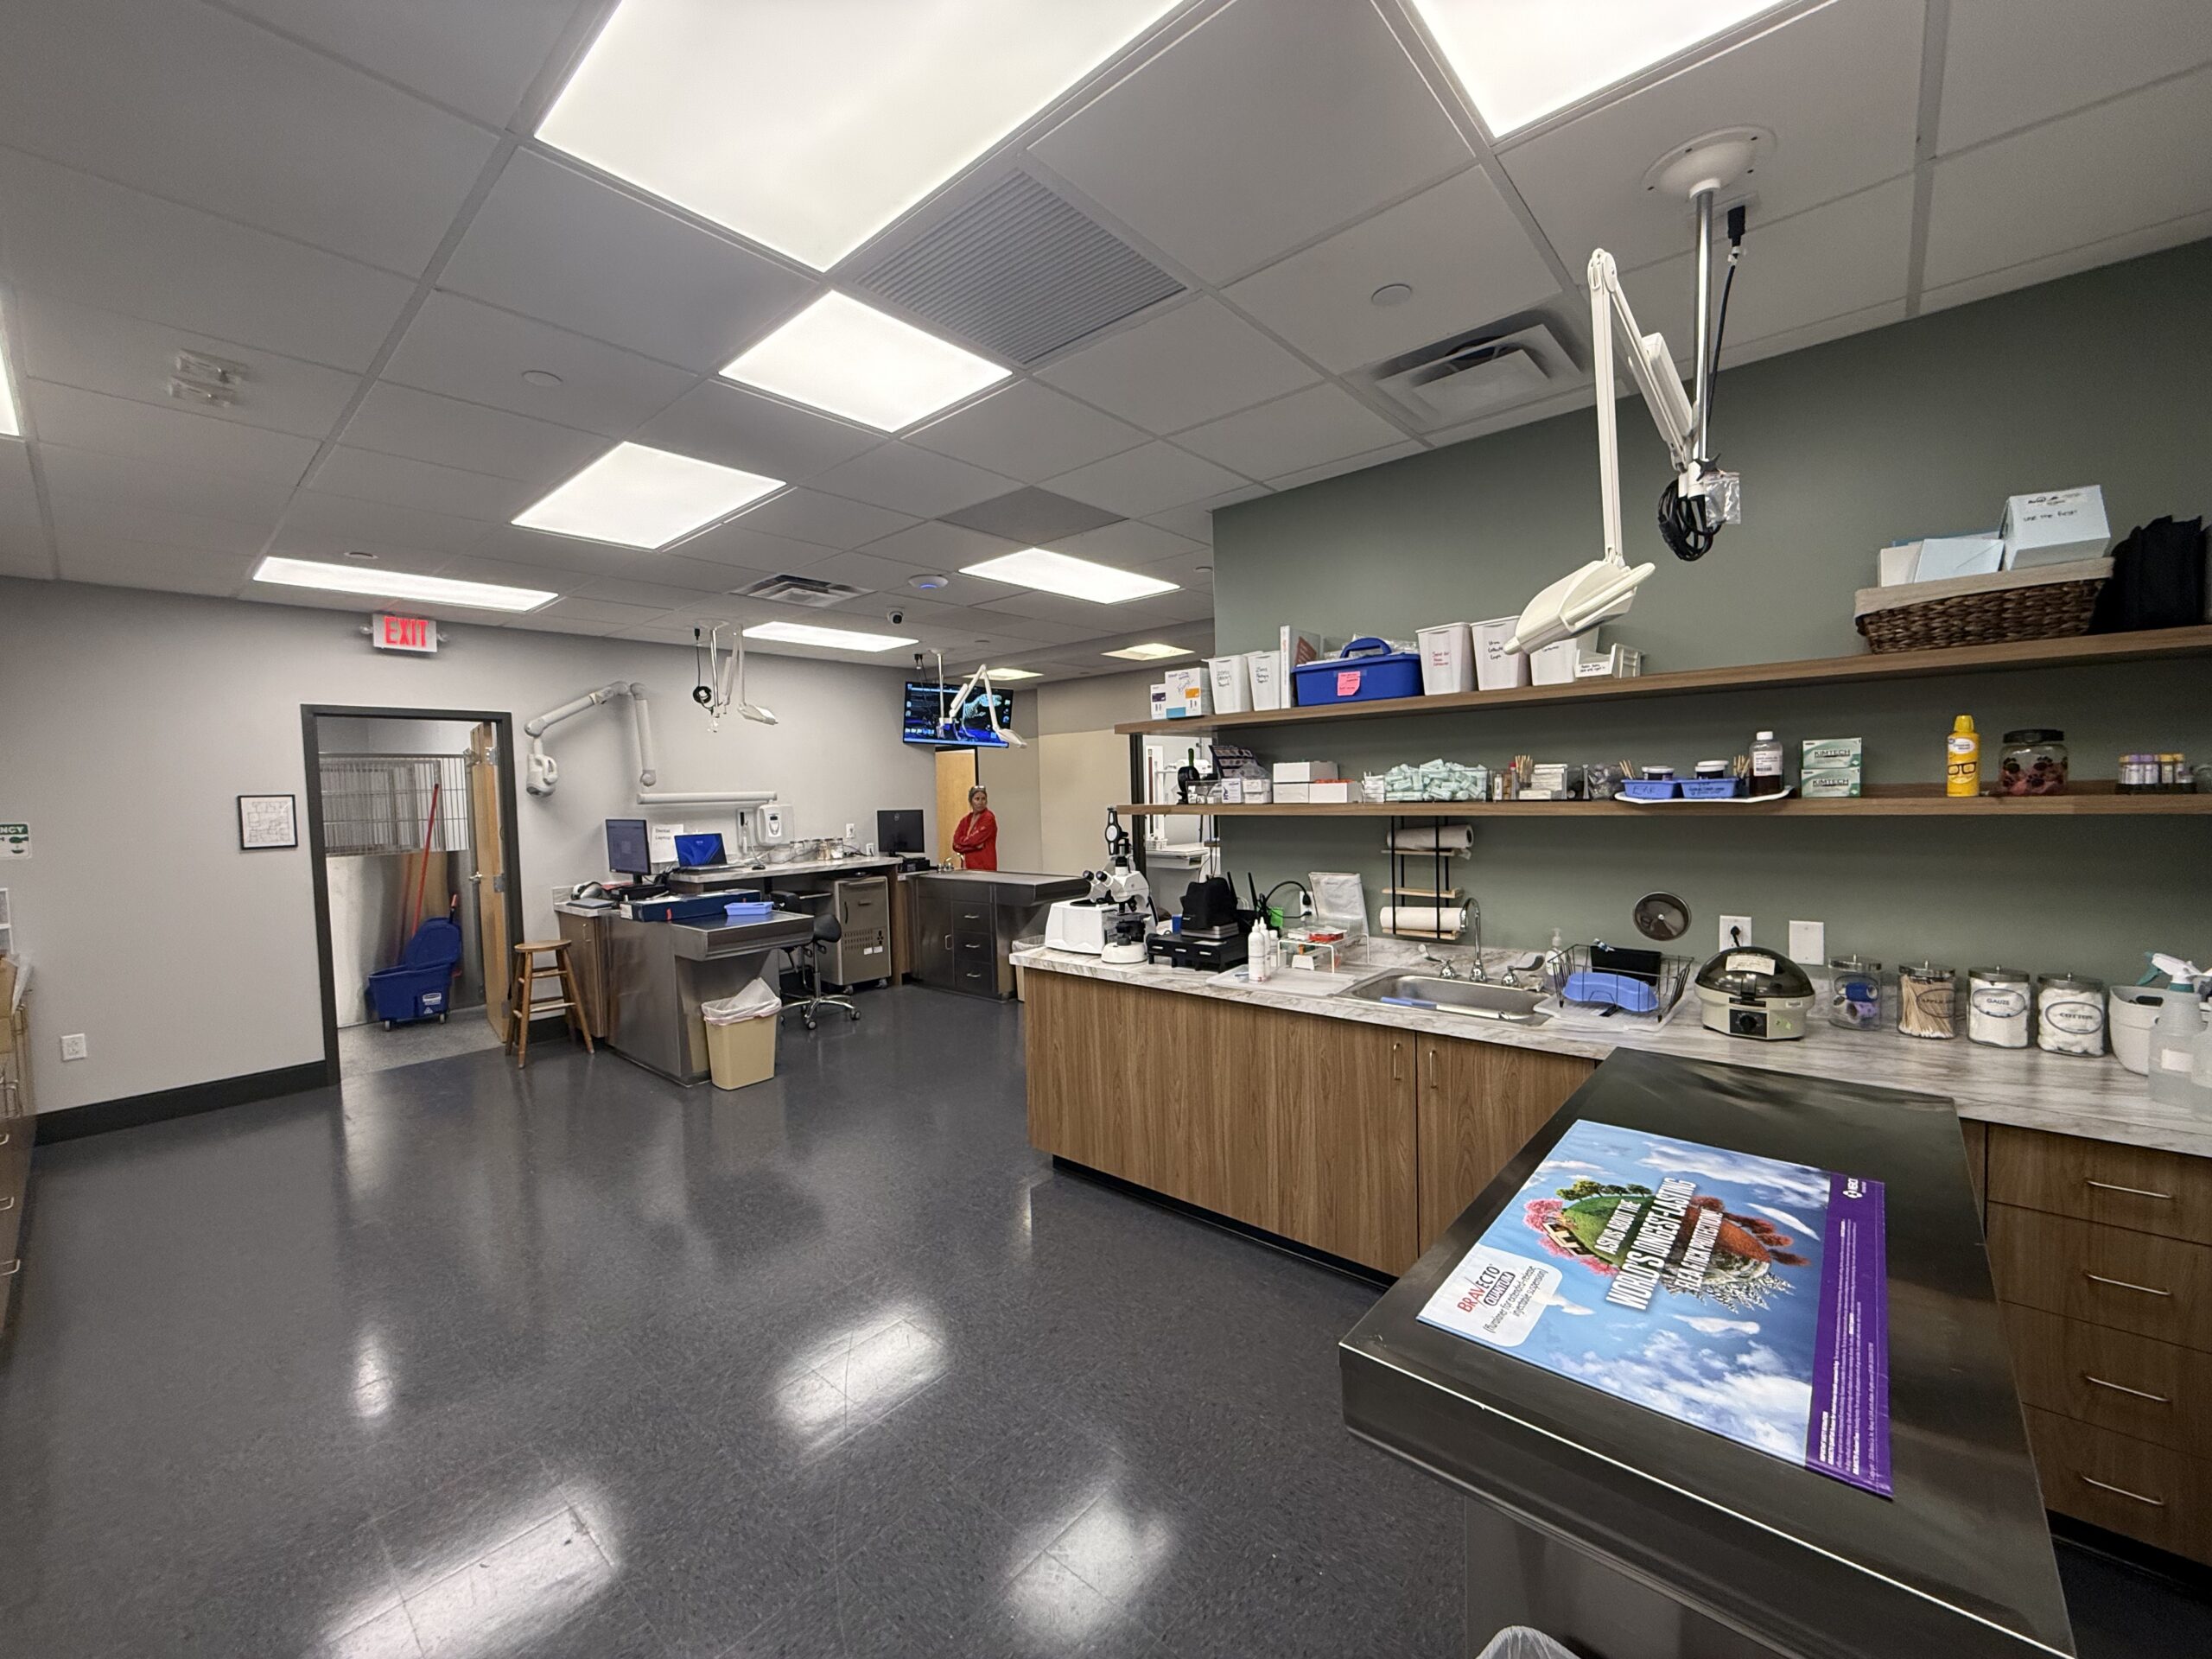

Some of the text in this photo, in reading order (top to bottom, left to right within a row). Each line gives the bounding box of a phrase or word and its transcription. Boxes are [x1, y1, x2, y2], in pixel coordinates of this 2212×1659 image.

[384, 616, 429, 647] EXIT
[1594, 1199, 1641, 1255] ASK US ABOUT THE
[1605, 1177, 1696, 1310] WORLD'S LONGEST-LASTING
[1689, 1208, 1724, 1252] PROTECTION!
[1684, 1246, 1710, 1268] TICK
[1457, 1265, 1500, 1313] BRAVECTO
[1485, 1274, 1512, 1305] QUANTUM
[1500, 1300, 1511, 1310] for
[1508, 1266, 1536, 1305] extended-release
[1510, 1268, 1548, 1316] injectable suspension)
[1675, 1268, 1704, 1291] FLEA
